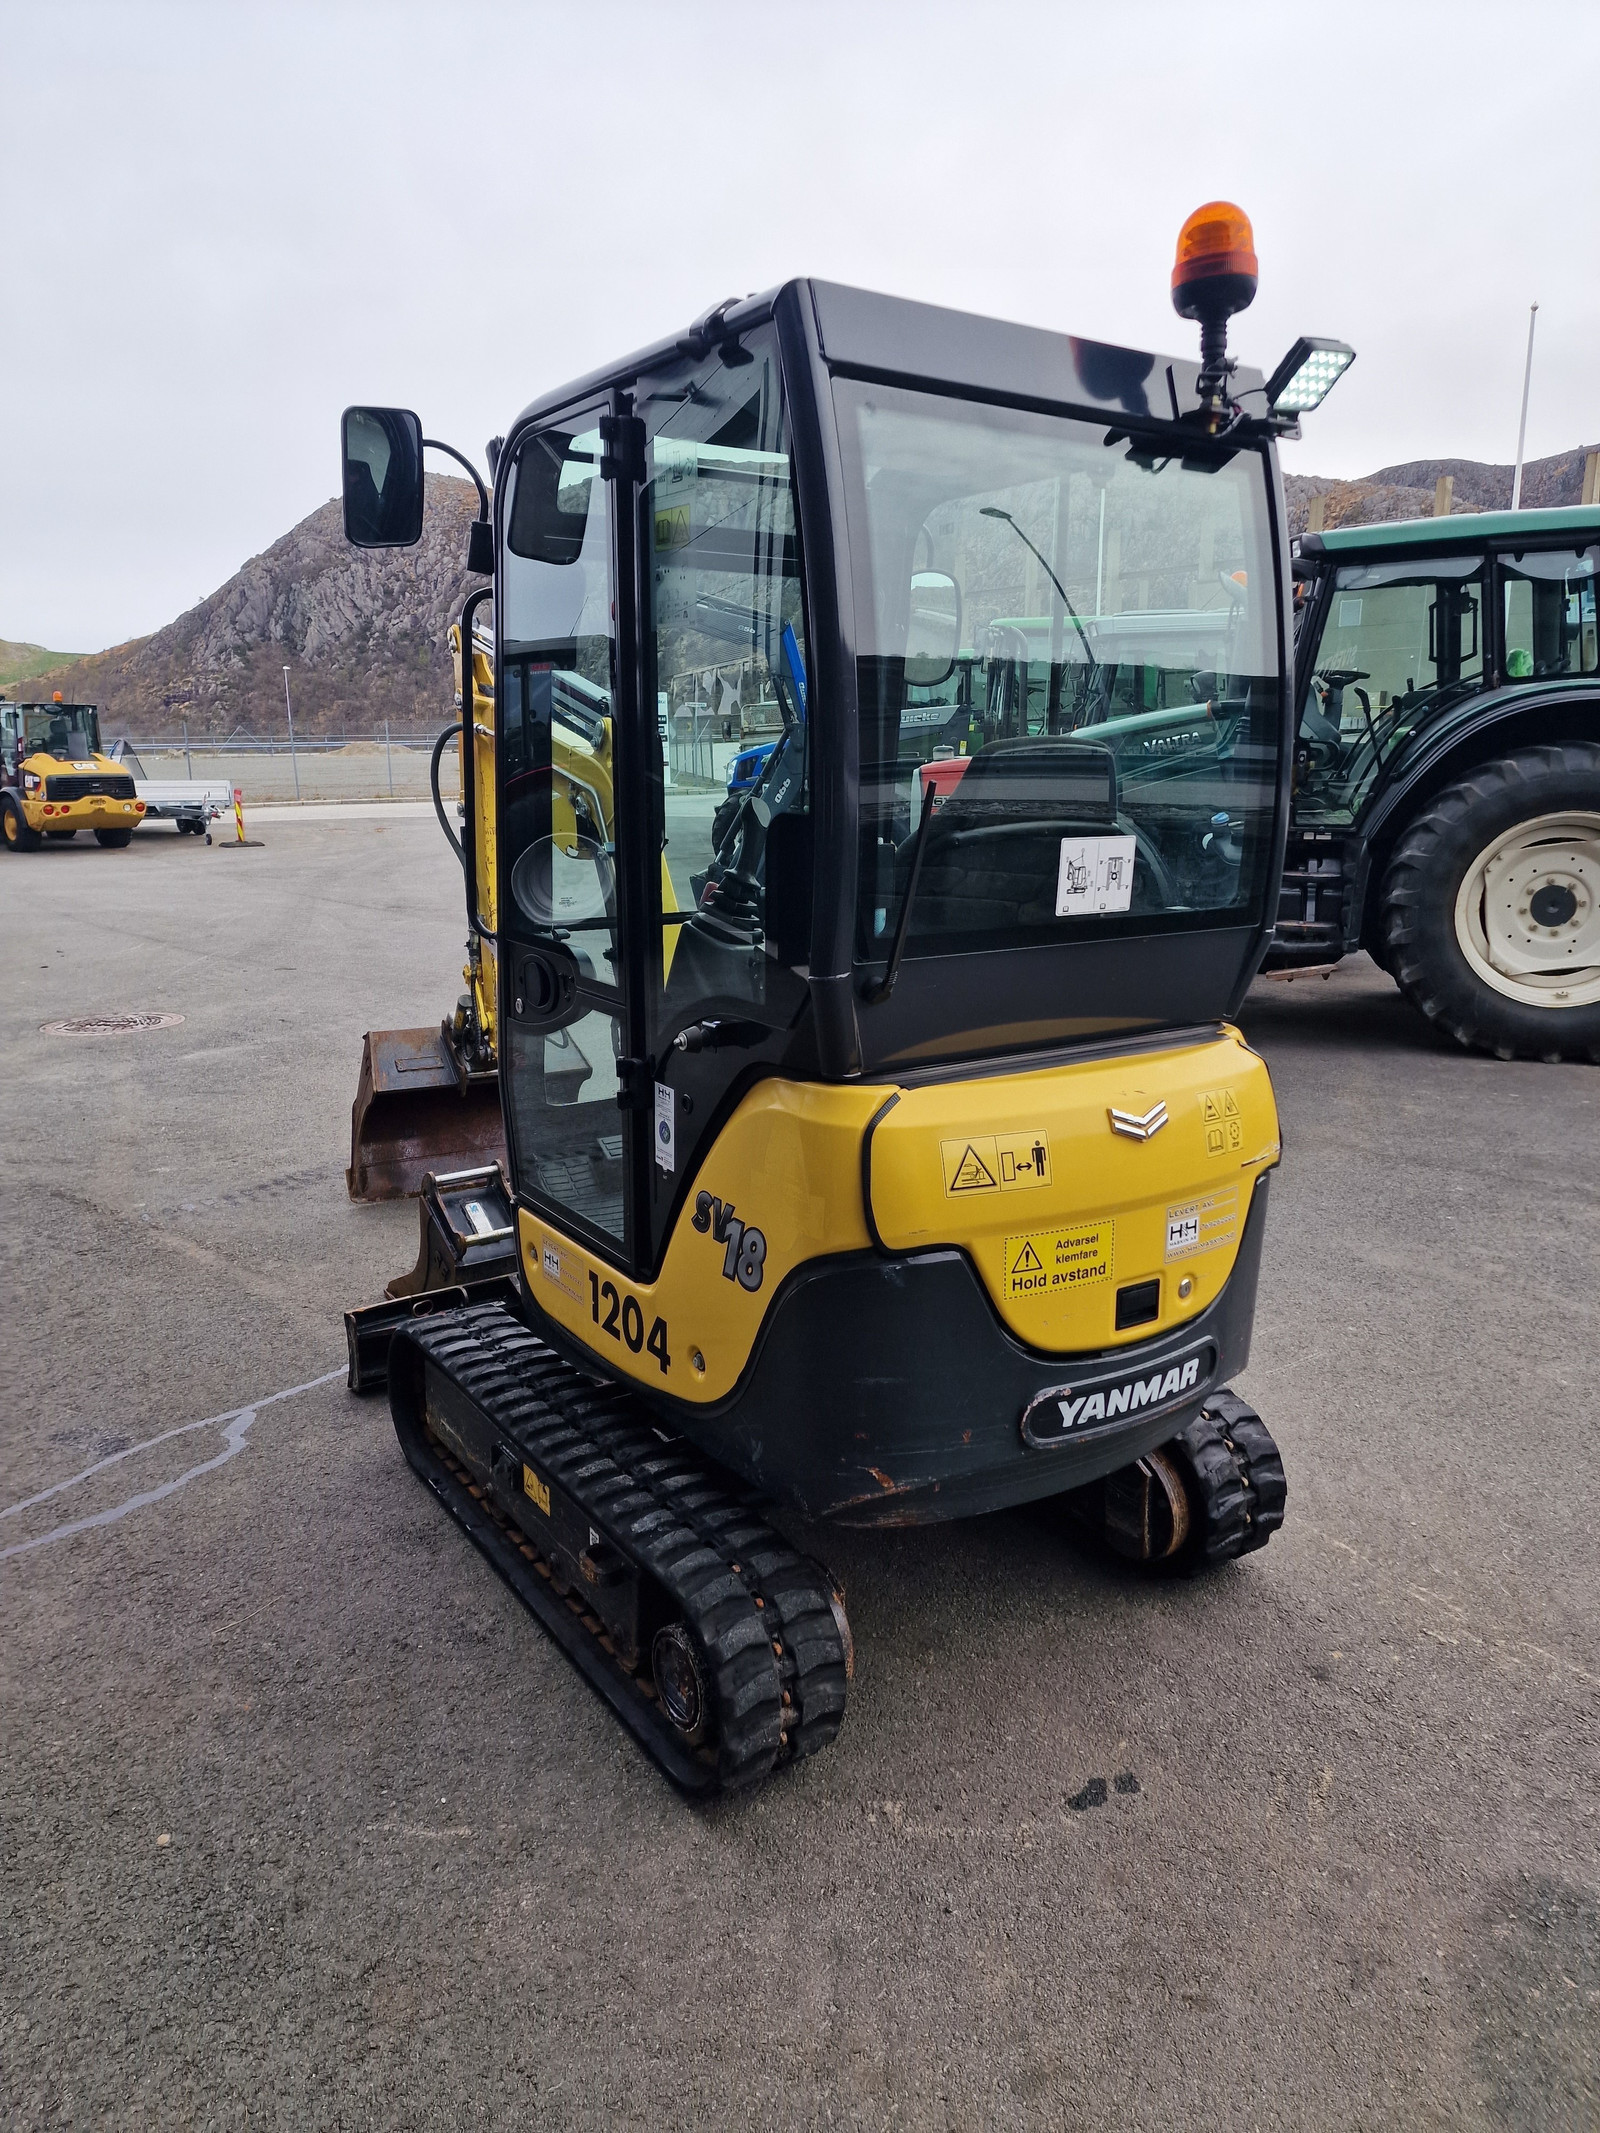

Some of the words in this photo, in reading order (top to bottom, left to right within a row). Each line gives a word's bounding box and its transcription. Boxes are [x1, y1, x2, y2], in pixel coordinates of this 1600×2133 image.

[900, 712, 940, 723] uicke
[1143, 731, 1201, 754] VALTRA
[1168, 1204, 1199, 1218] LEVERT
[691, 1189, 767, 1293] SV18
[1055, 1233, 1099, 1250] Advarsel
[1055, 1249, 1098, 1265] klemfare
[1012, 1273, 1047, 1292] Hold
[1052, 1262, 1106, 1285] avstand
[588, 1269, 671, 1376] 1204
[1057, 1358, 1200, 1428] YANMAR
